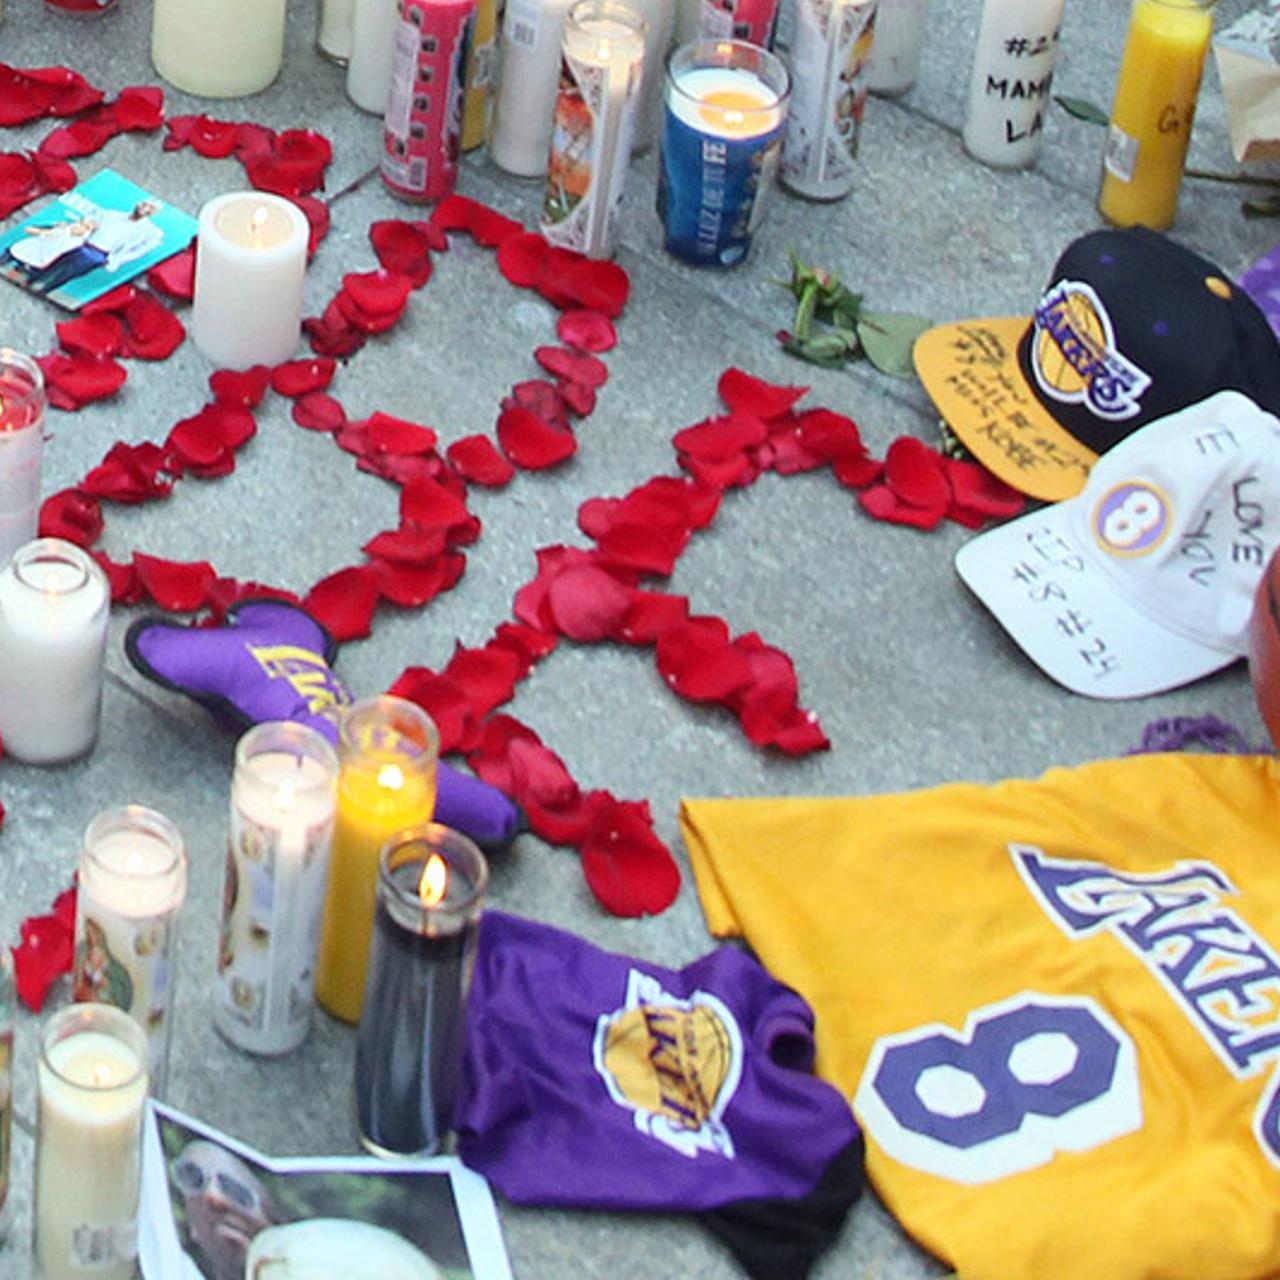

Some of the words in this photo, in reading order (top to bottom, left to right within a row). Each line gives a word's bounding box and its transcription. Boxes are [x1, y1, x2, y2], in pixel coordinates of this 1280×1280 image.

[710, 139, 728, 166] FE
[1036, 289, 1139, 420] LAKERS
[1103, 488, 1161, 550] 8
[1181, 509, 1217, 588] YOU
[1230, 476, 1266, 568] LOVE
[860, 992, 1139, 1178] 8
